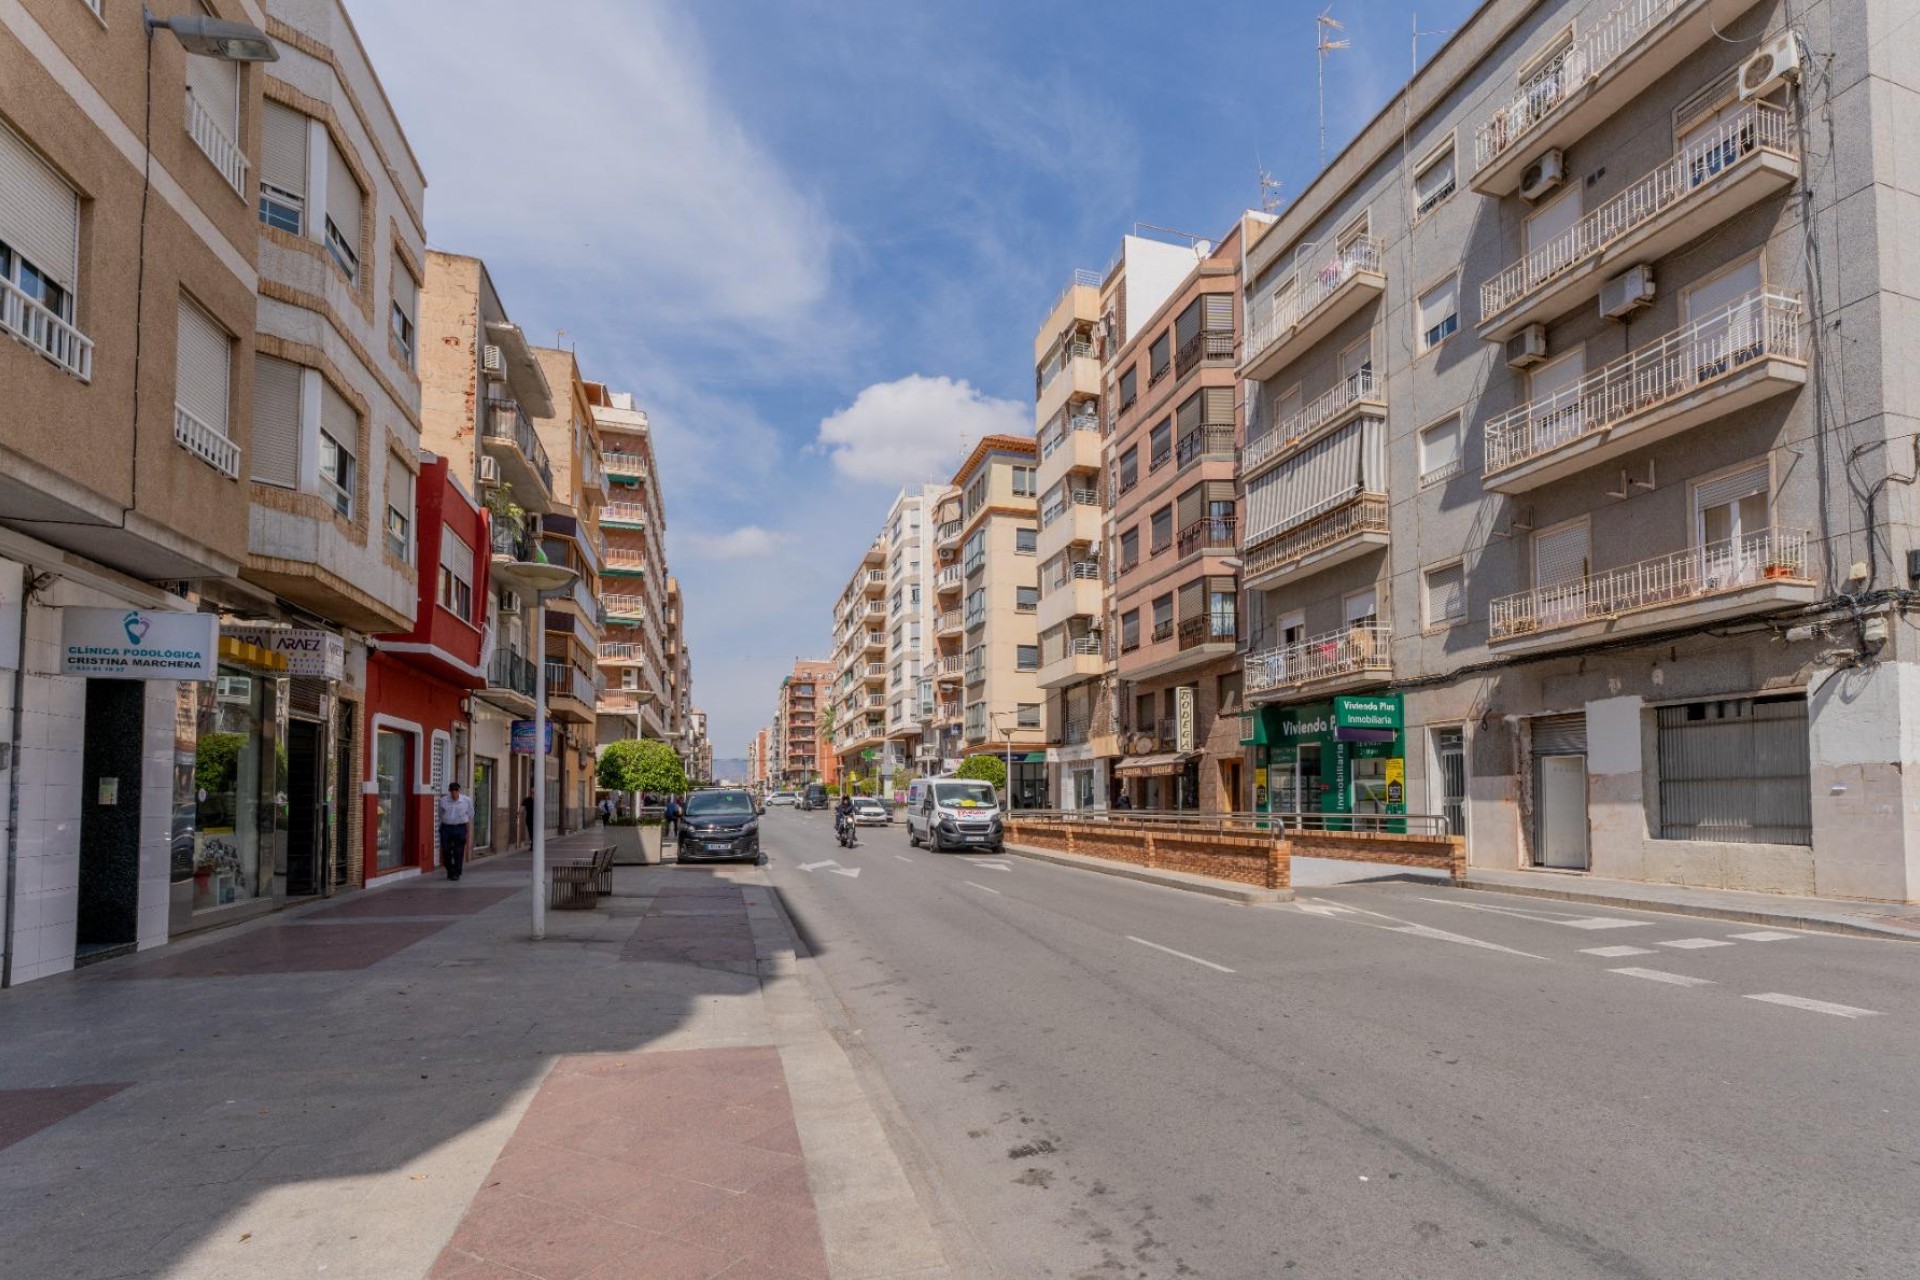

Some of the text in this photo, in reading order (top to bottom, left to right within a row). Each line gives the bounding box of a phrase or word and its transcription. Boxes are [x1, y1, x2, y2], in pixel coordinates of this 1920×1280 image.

[276, 638, 321, 651] ARAEZ
[68, 645, 202, 660] CLÍNICA PODOLÓGICA
[67, 657, 202, 669] CRISTINA MARCHENA
[1343, 701, 1395, 711] Vivienda Plus
[1180, 691, 1190, 749] BODEGA
[1283, 716, 1328, 736] Vivienda
[1336, 743, 1344, 810] Inmobiliaria
